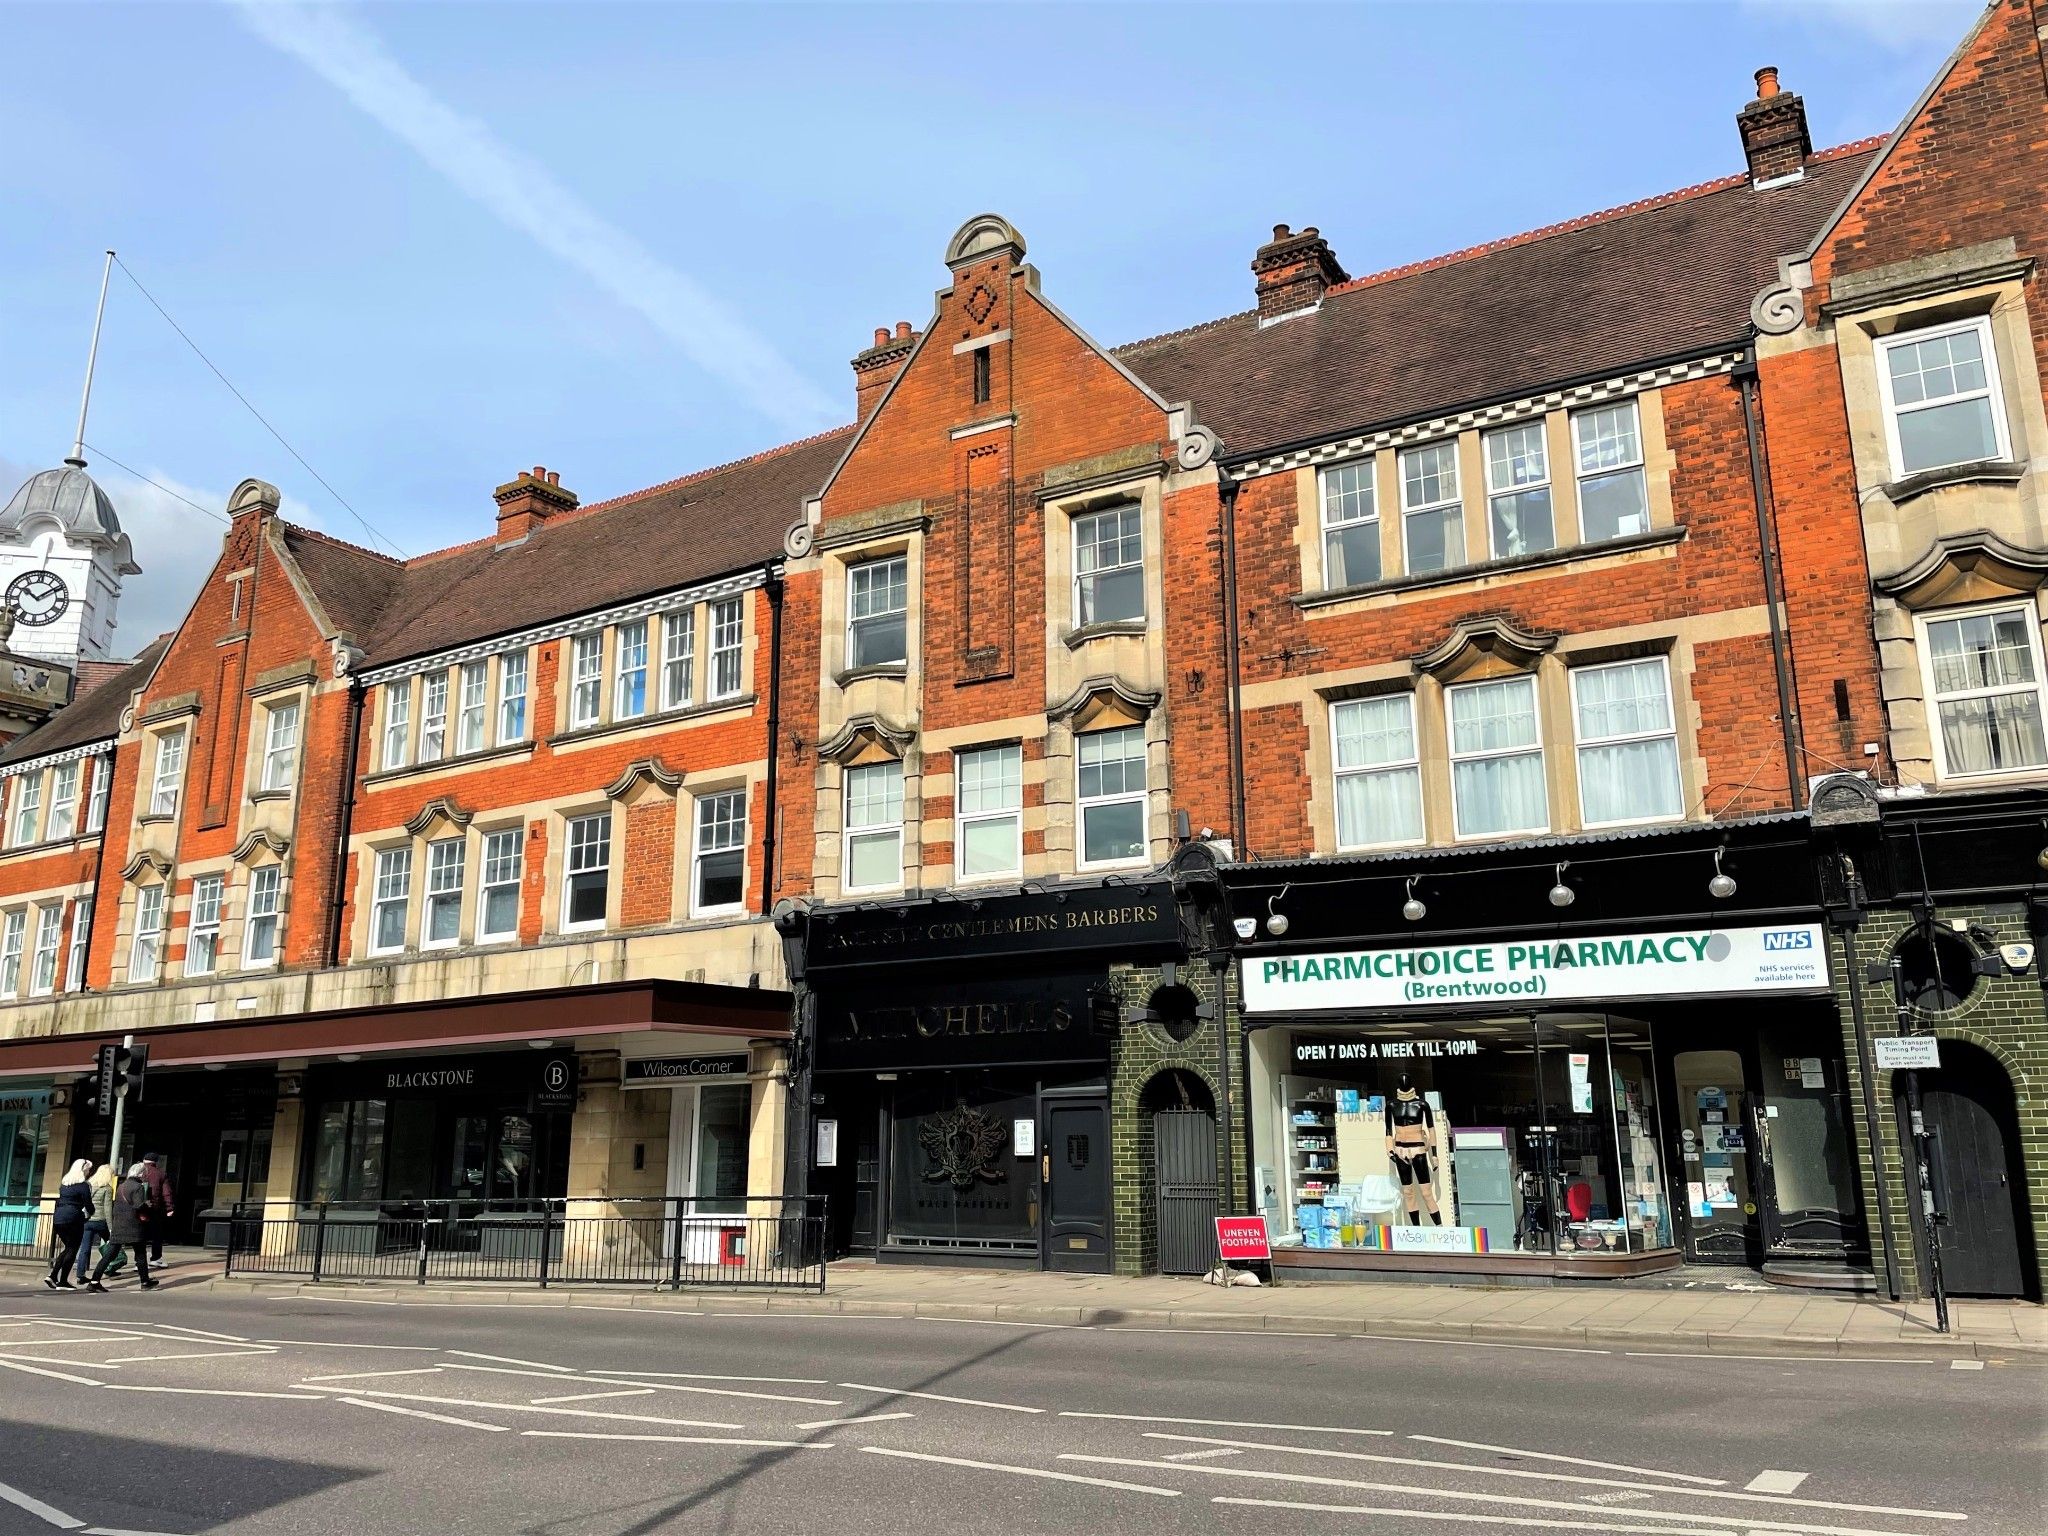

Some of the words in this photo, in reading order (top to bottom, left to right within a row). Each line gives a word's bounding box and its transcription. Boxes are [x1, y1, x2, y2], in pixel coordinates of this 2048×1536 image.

[1066, 905, 1158, 929] BARBERS
[1766, 931, 1809, 950] NHS
[1263, 948, 1494, 984] PHARMCHOICE
[1507, 935, 1711, 971] PHARMACY
[1759, 964, 1778, 973] NHS
[1780, 963, 1815, 972] services
[1754, 973, 1794, 982] available
[1796, 972, 1816, 980] here
[1404, 974, 1547, 1001] (Brentwood)
[840, 998, 1073, 1040] TCHELLS
[1297, 1045, 1327, 1061] OPEN
[1328, 1044, 1336, 1059] 7
[1338, 1043, 1367, 1059] DAYS
[1369, 1043, 1379, 1058] A
[1381, 1042, 1415, 1058] WEEK
[1416, 1041, 1444, 1057] TILL
[1445, 1039, 1478, 1056] 10PM
[1901, 1039, 1934, 1047] Transport
[551, 1066, 563, 1085] B
[643, 1061, 688, 1076] Wilsons
[689, 1059, 734, 1075] Corner
[387, 1069, 474, 1088] BLACKSTONE
[1223, 1228, 1261, 1237] UNEVEN
[1221, 1238, 1266, 1247] FOOTPATH
